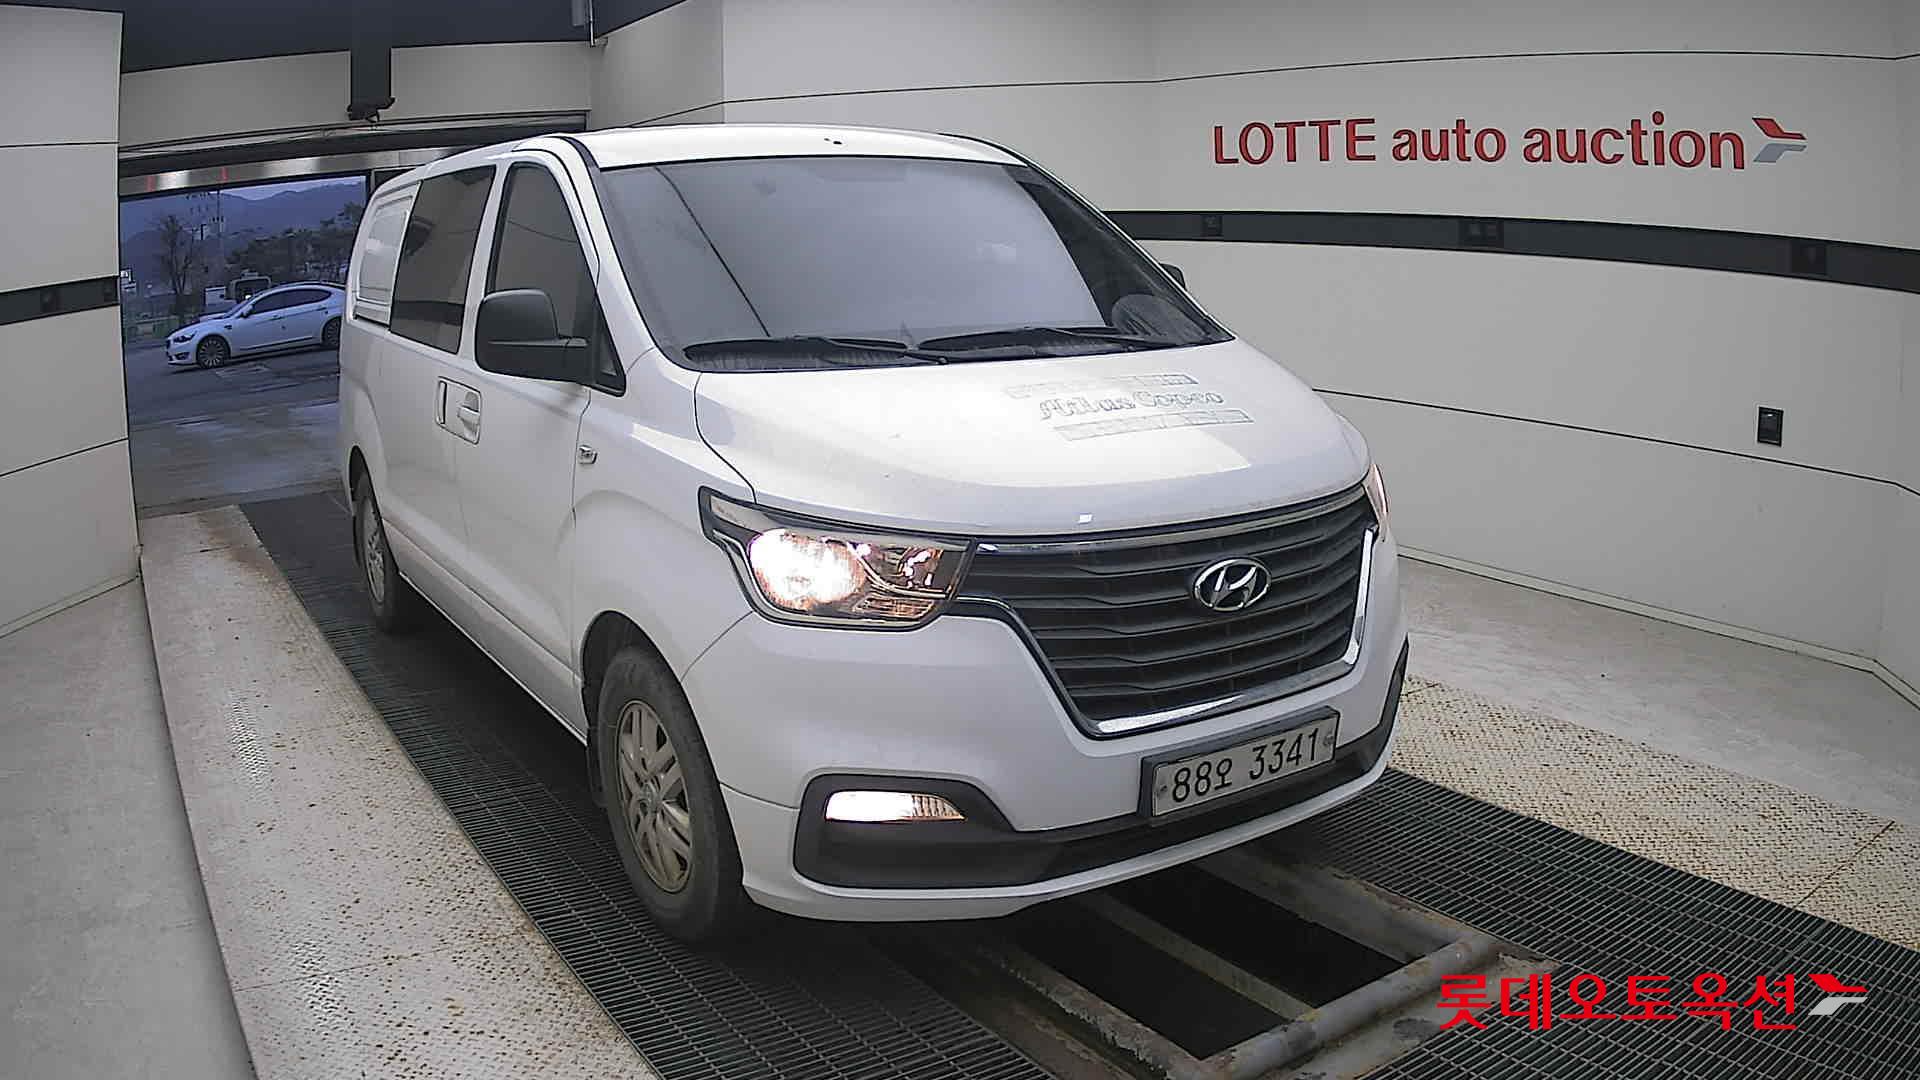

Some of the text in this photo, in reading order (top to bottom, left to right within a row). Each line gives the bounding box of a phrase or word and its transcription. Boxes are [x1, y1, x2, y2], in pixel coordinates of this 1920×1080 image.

[1212, 111, 1745, 169] LOTTE auto auction
[1172, 727, 1319, 802] 88오 3341
